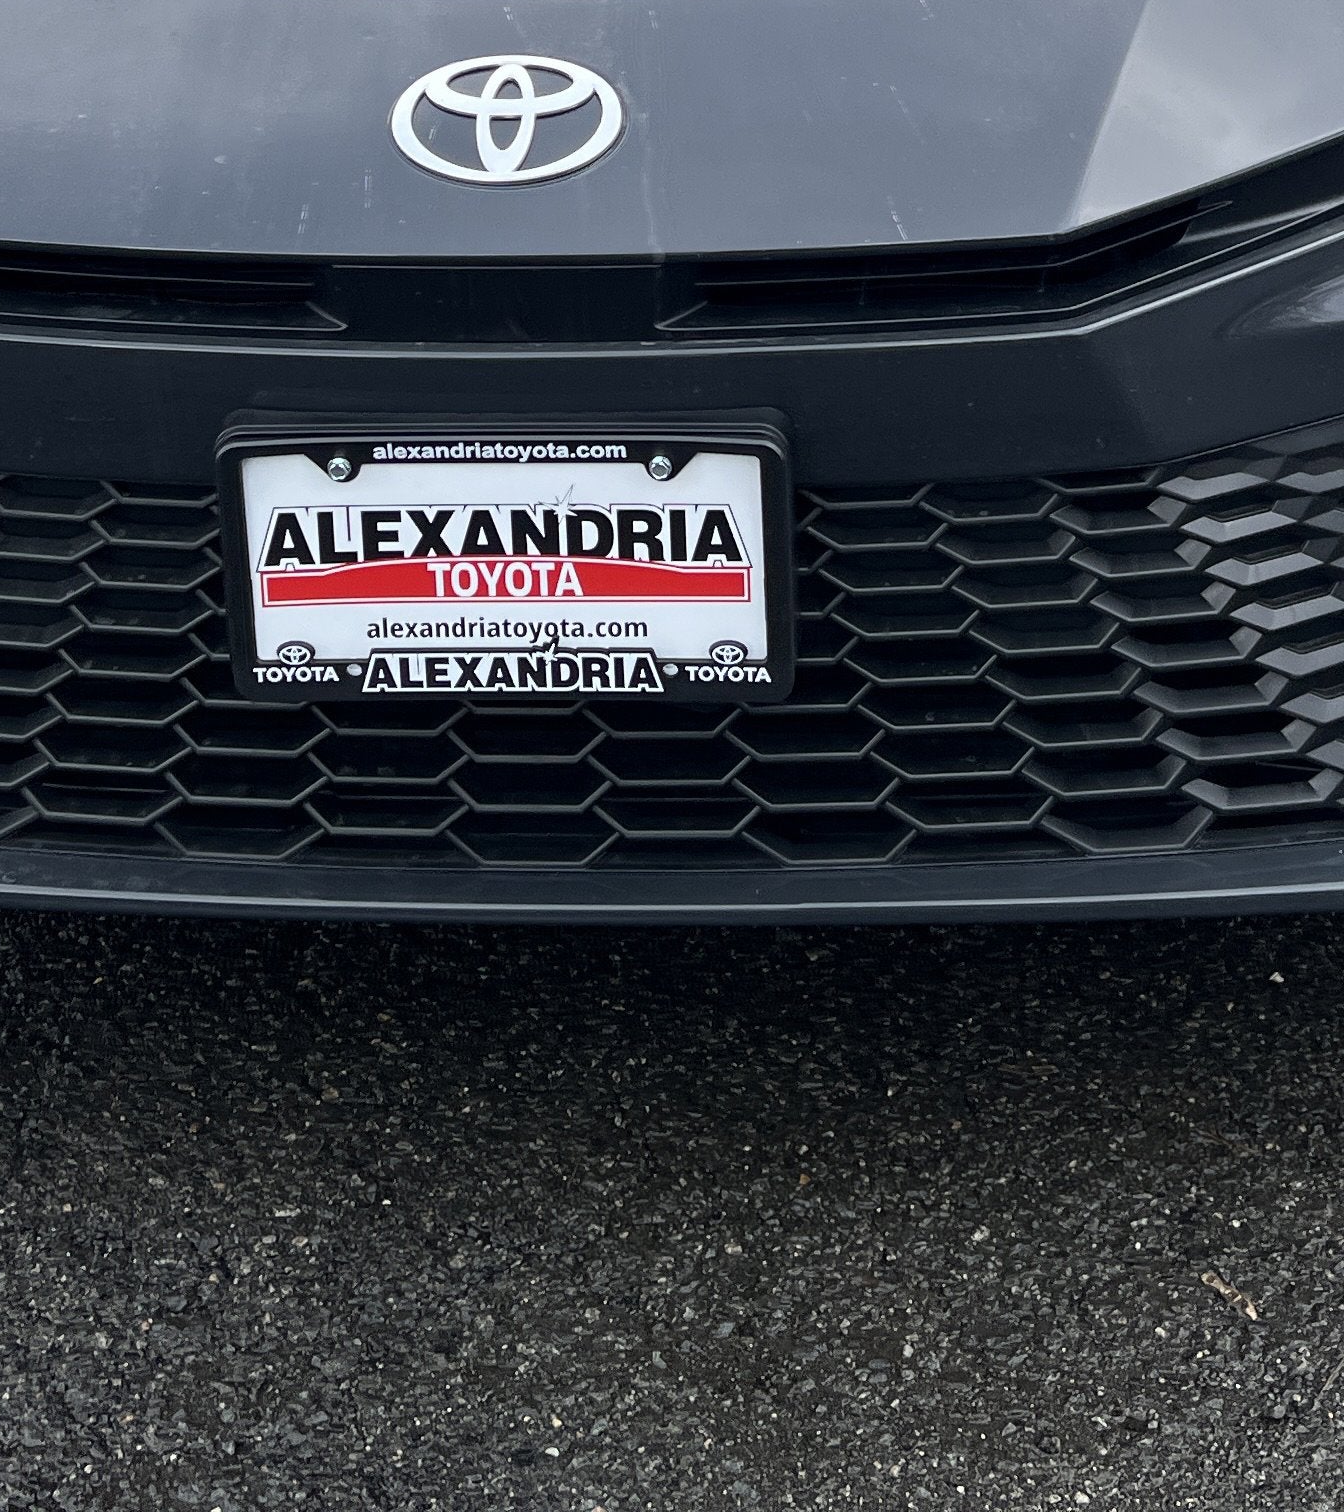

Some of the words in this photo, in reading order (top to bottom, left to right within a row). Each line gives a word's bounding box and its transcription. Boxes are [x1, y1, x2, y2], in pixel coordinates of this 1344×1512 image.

[372, 441, 627, 462] alexandriatoyota.com
[262, 506, 744, 567] ALEXANDRIA
[426, 560, 584, 598] TOYOTA
[366, 616, 649, 643] alexandriatoyota.com
[252, 664, 340, 684] TOYOTA
[363, 650, 664, 692] ALEXANDRIA
[684, 664, 772, 684] TOYOTA
